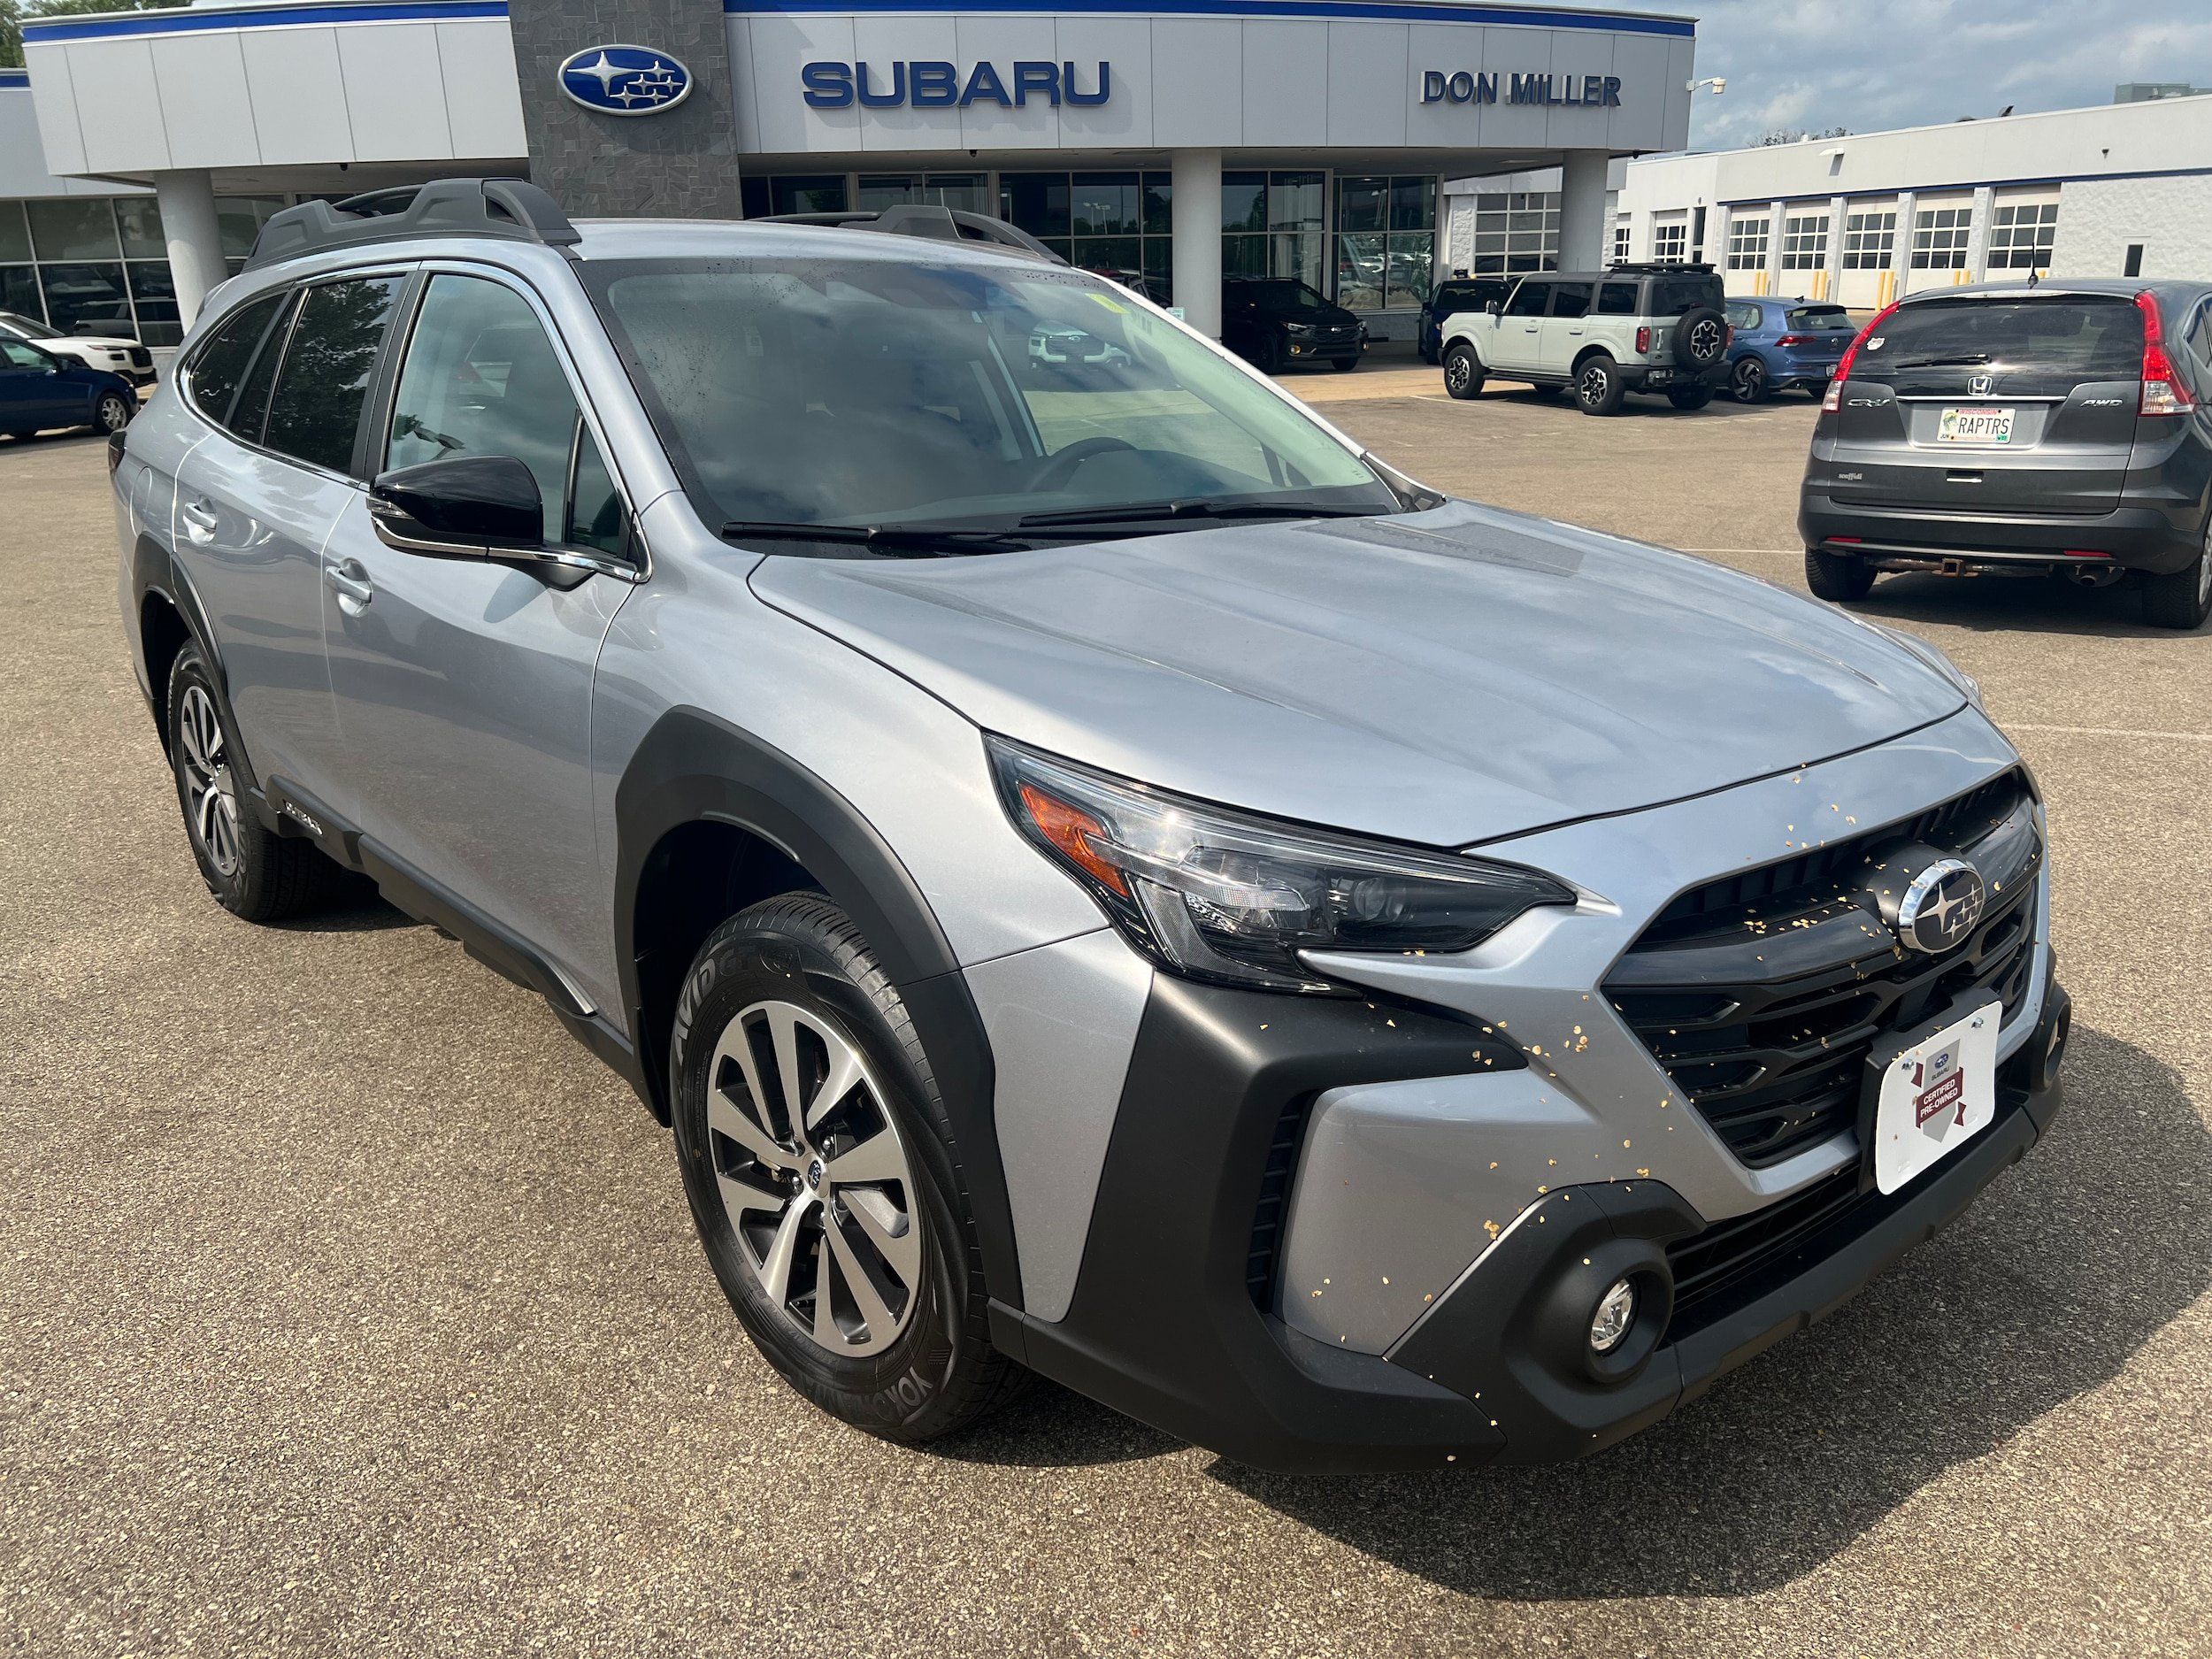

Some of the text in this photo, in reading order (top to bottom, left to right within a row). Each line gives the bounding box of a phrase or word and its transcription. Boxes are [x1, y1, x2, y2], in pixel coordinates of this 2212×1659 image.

[802, 61, 1110, 108] SUBARU
[1420, 71, 1621, 106] DON MILLER
[1958, 418, 2010, 434] RAPTRS
[673, 958, 717, 1067] AVID
[1932, 1066, 1949, 1080] SUBARU
[1920, 1087, 1958, 1118] PRE-OWNED
[1924, 1079, 1955, 1105] CERTIFIED
